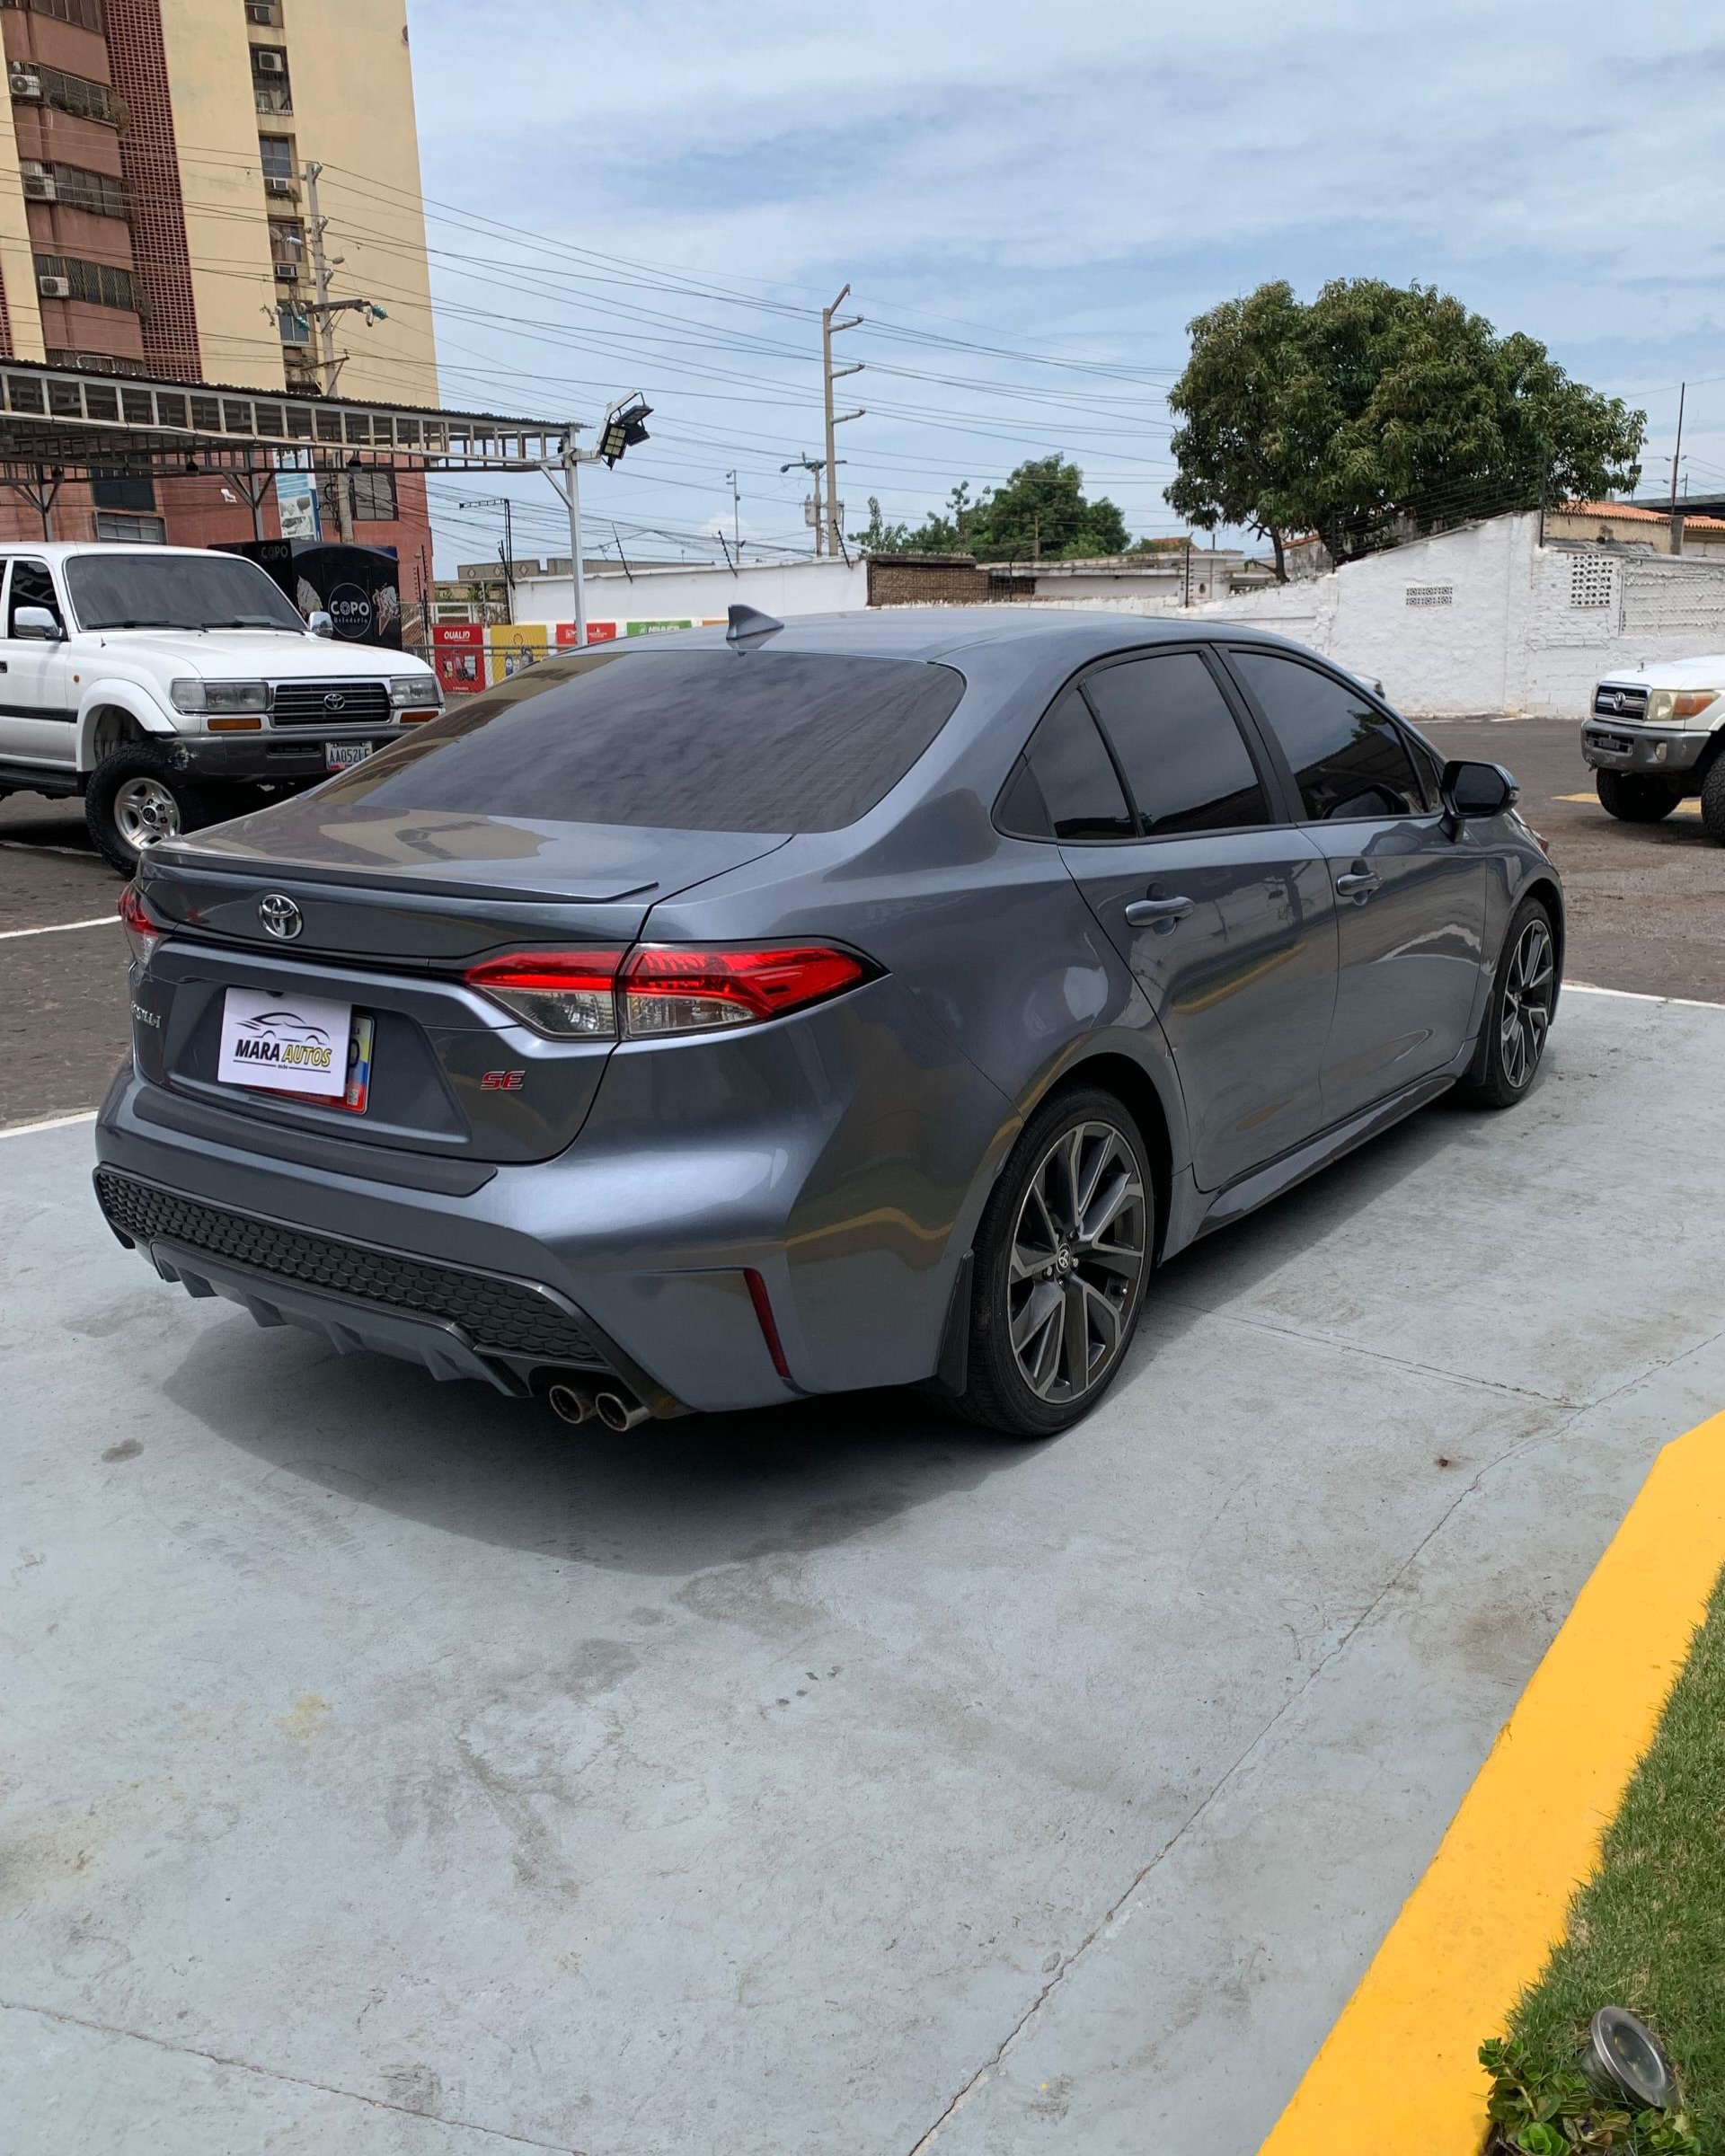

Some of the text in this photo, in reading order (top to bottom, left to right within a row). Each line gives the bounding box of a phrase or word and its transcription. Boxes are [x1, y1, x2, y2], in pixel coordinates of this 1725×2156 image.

[331, 601, 369, 616] COPO
[234, 1039, 279, 1062] MARA
[281, 1045, 332, 1067] AUTOS
[480, 1070, 526, 1091] SE
